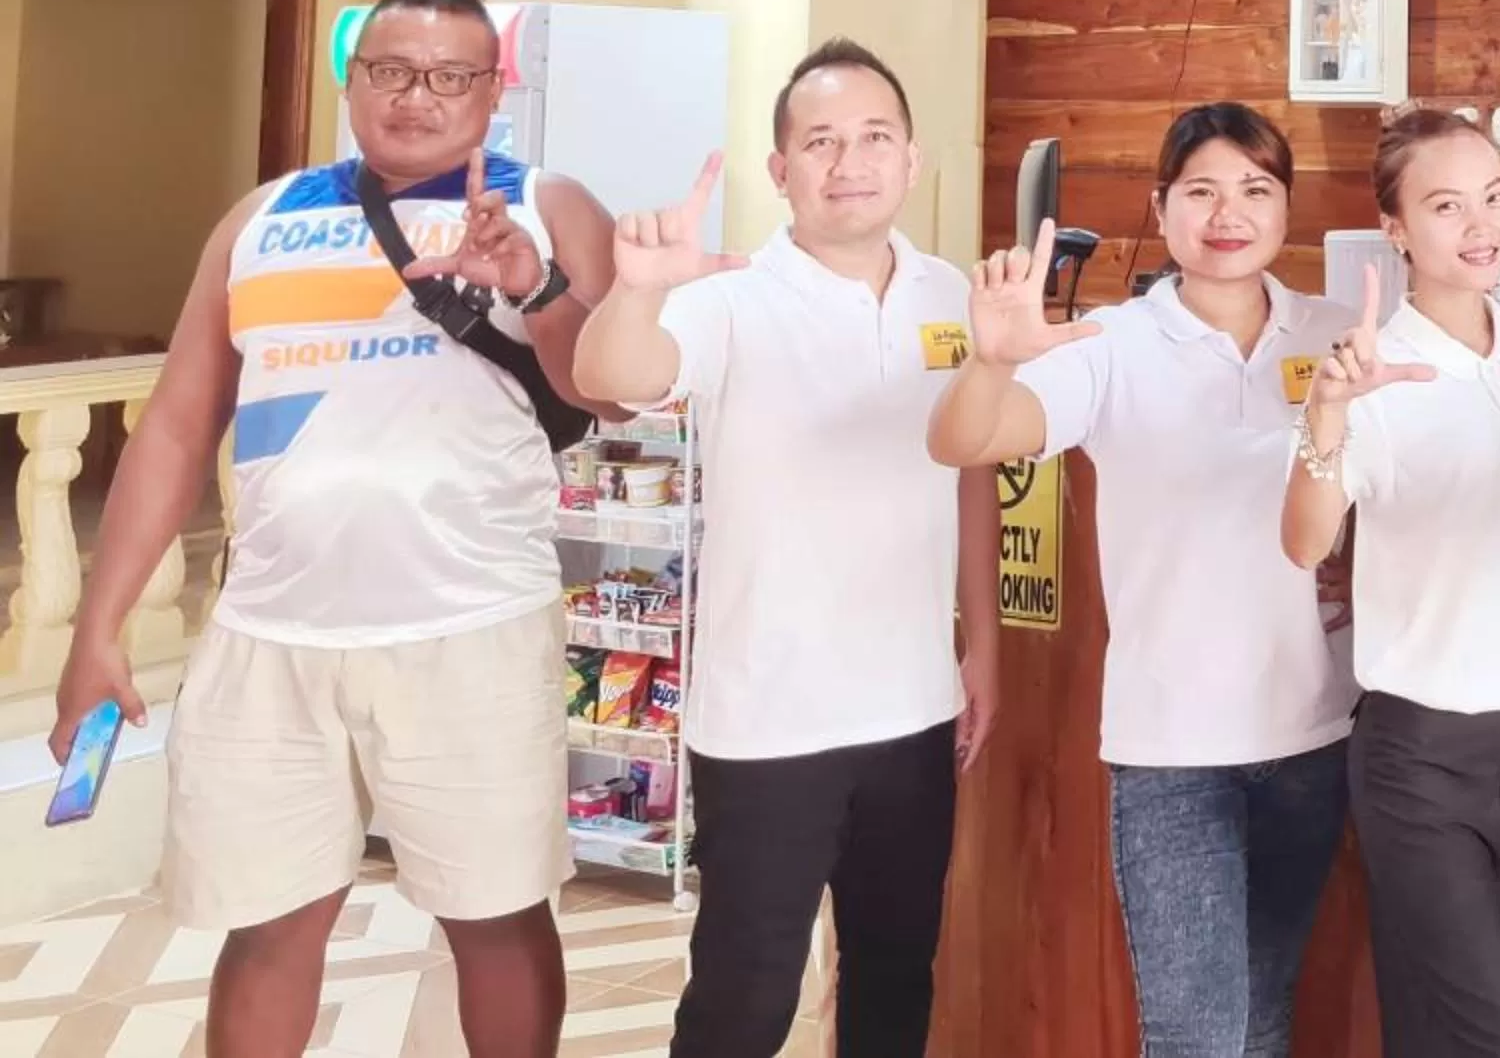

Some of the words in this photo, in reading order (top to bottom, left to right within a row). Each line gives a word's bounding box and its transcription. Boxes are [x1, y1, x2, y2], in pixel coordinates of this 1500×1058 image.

[258, 216, 370, 255] COAST
[262, 334, 439, 371] SIQUIJOR
[1000, 525, 1041, 564] CTLY
[1000, 571, 1054, 615] OKING
